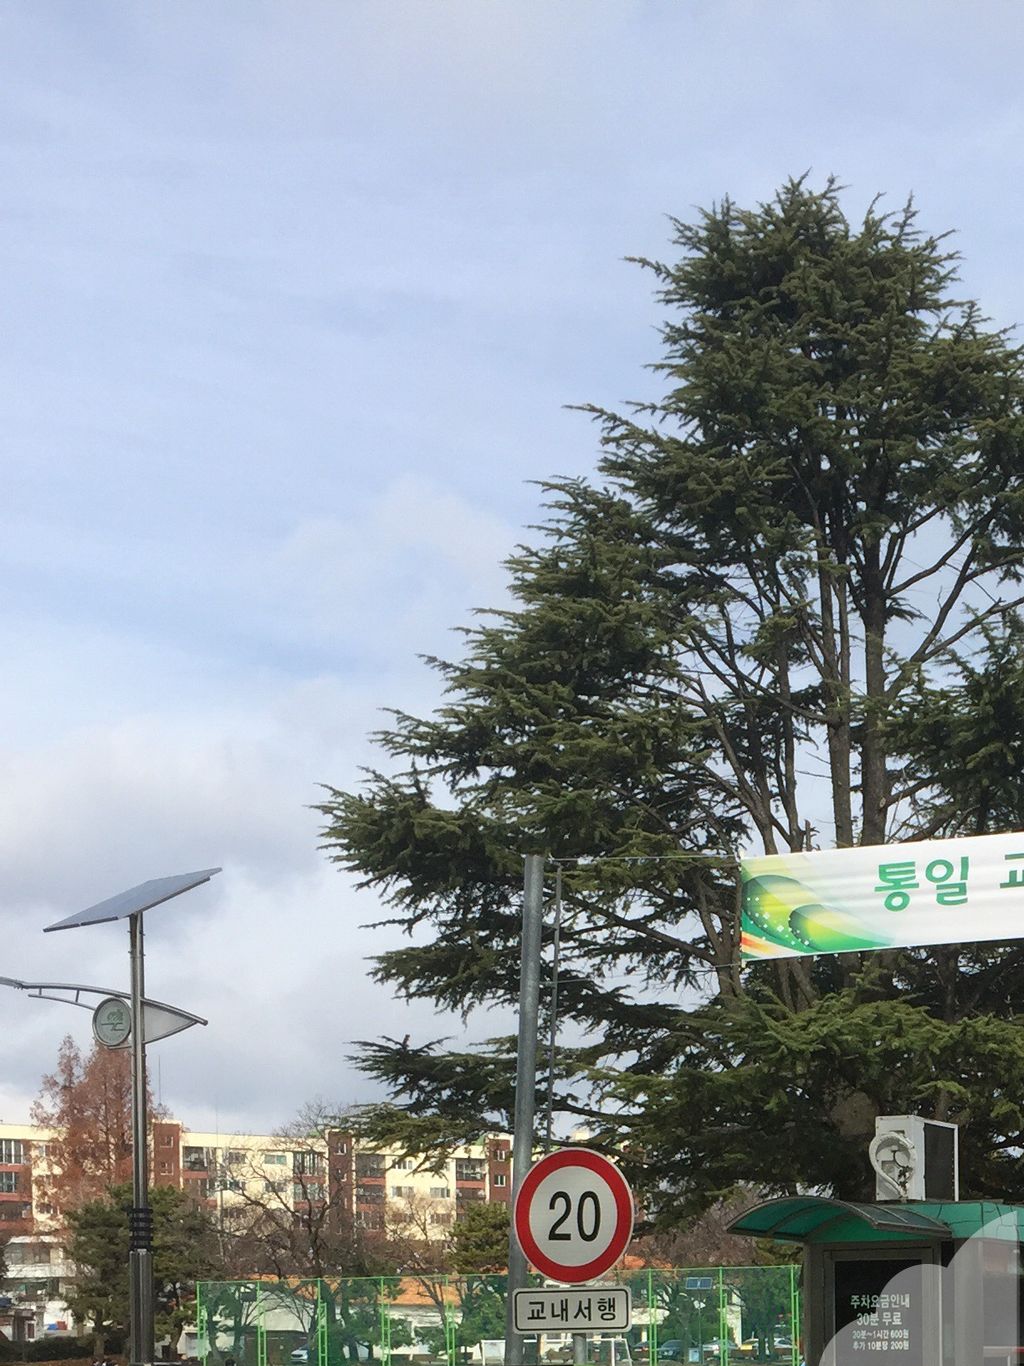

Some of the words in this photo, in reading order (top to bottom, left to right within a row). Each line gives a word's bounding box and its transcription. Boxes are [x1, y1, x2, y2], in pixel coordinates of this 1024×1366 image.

[874, 856, 970, 912] 통일
[547, 1190, 601, 1242] 20
[527, 1297, 617, 1323] 교내서행
[856, 1311, 879, 1326] 30분
[882, 1311, 902, 1326] 무료
